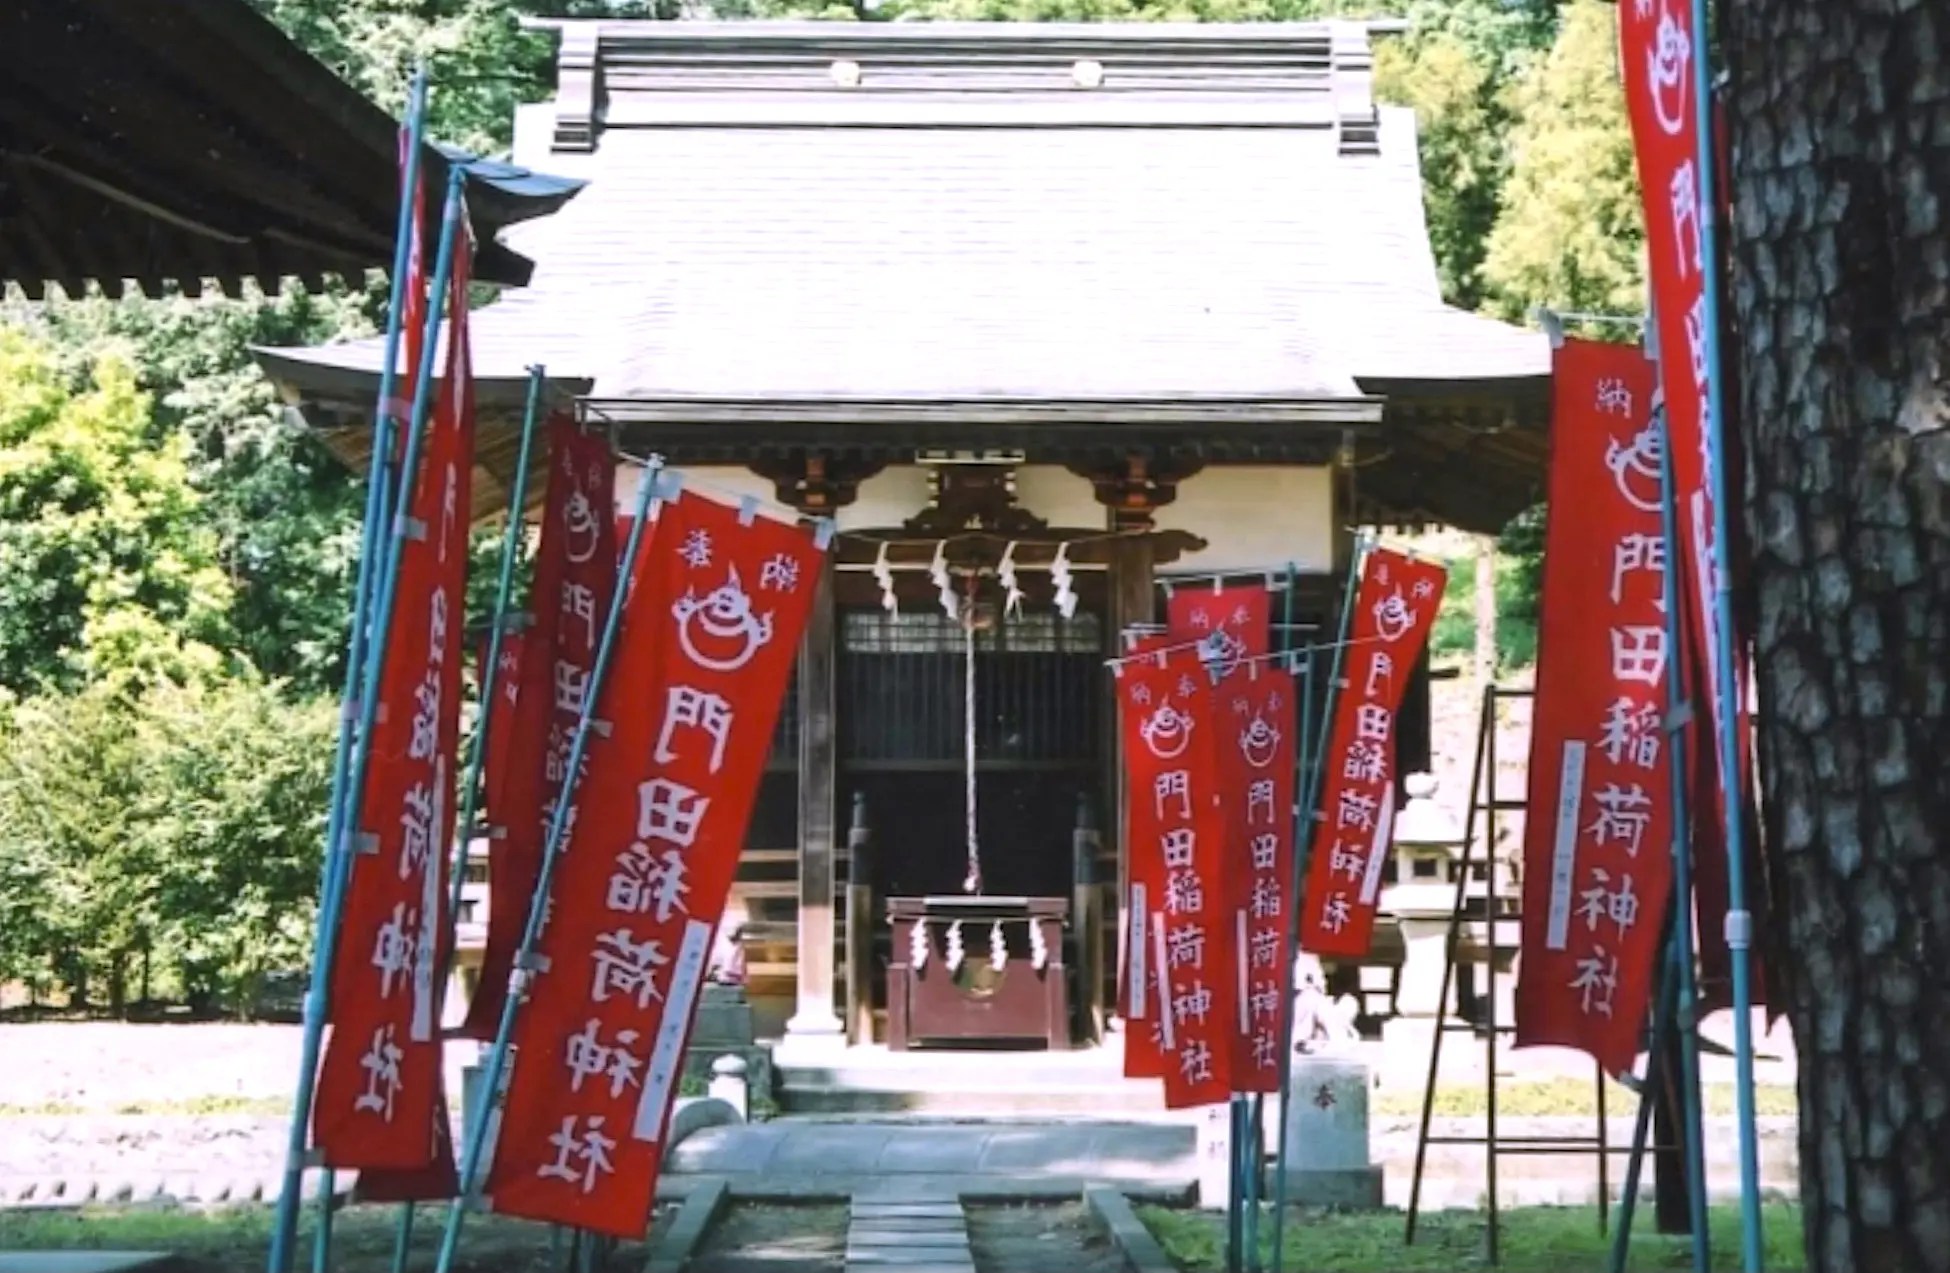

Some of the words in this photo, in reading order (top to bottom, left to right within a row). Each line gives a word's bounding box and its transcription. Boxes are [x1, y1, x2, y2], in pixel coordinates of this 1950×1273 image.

[1154, 769, 1213, 1086] 門田稲荷神社
[1248, 779, 1281, 1071] 門田稲荷神社
[1568, 533, 1668, 1020] 門田稲荷神社
